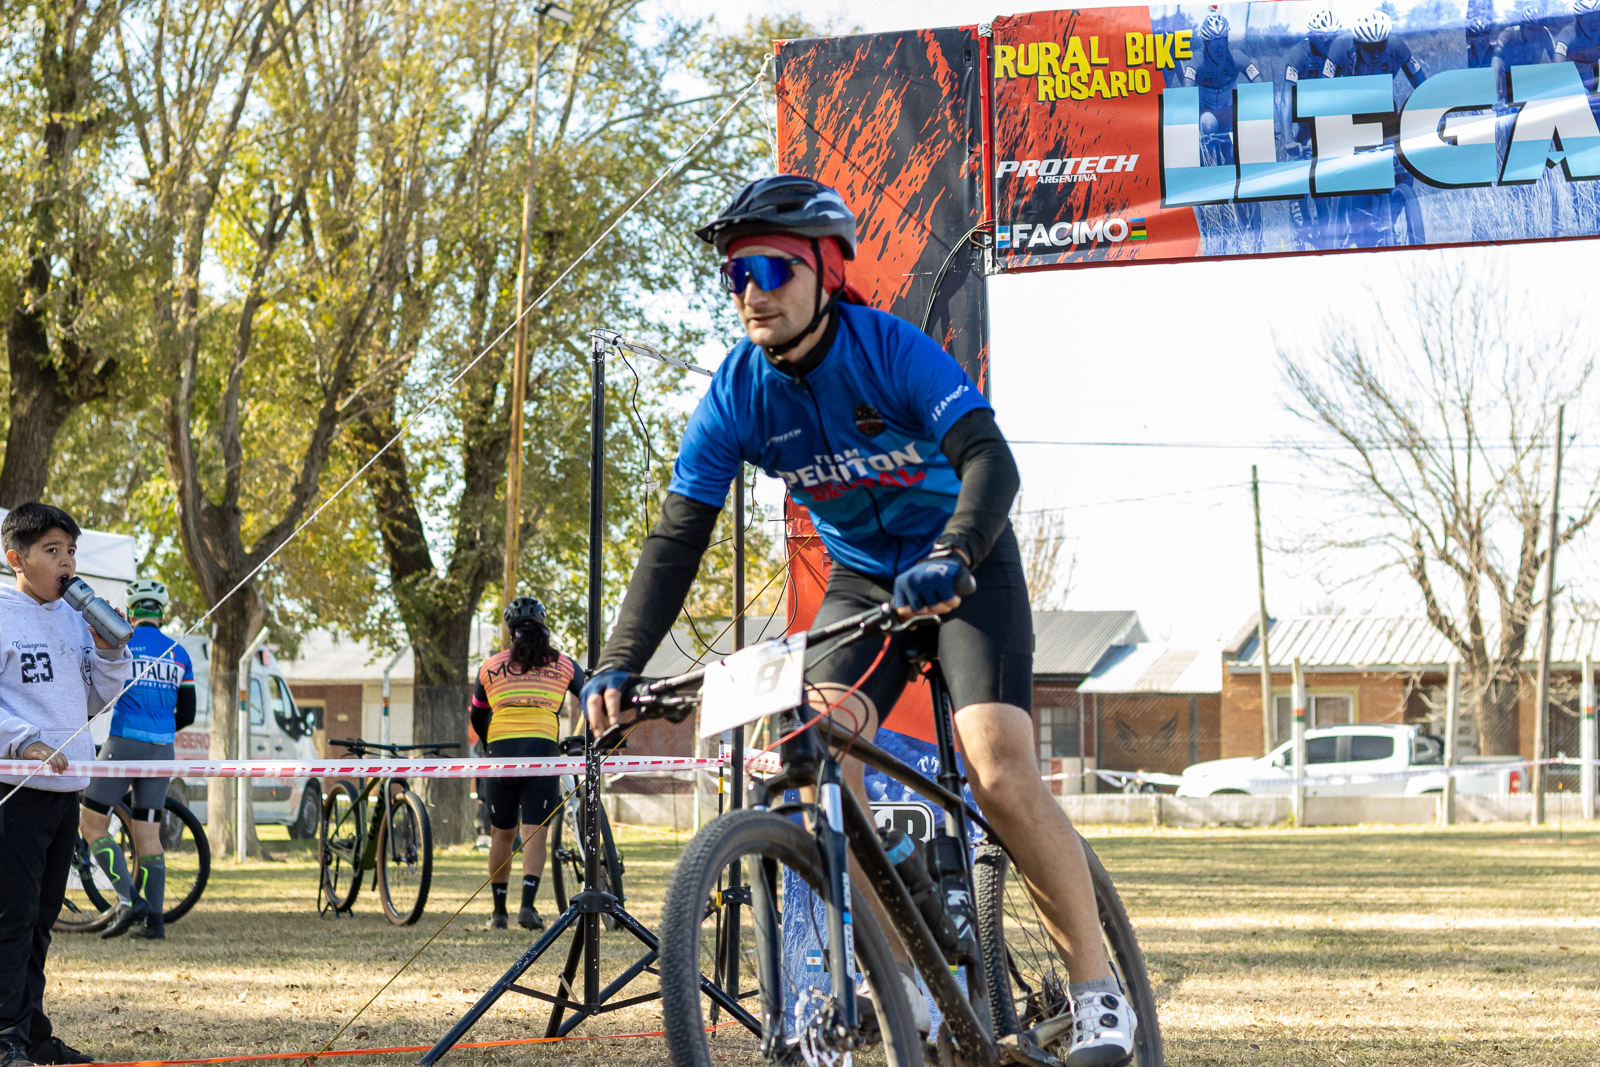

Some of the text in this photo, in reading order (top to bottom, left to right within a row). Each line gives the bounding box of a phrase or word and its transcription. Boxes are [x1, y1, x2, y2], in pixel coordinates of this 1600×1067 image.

[994, 29, 1194, 79] RURAL BIKE
[1038, 69, 1151, 102] ROSARIO
[1158, 58, 1600, 209] LLEGA
[995, 154, 1140, 179] PROTECH
[1036, 173, 1098, 185] ARGENTINA
[1012, 217, 1129, 249] FACIMO
[20, 652, 54, 684] 23
[132, 660, 178, 685] ITALIA
